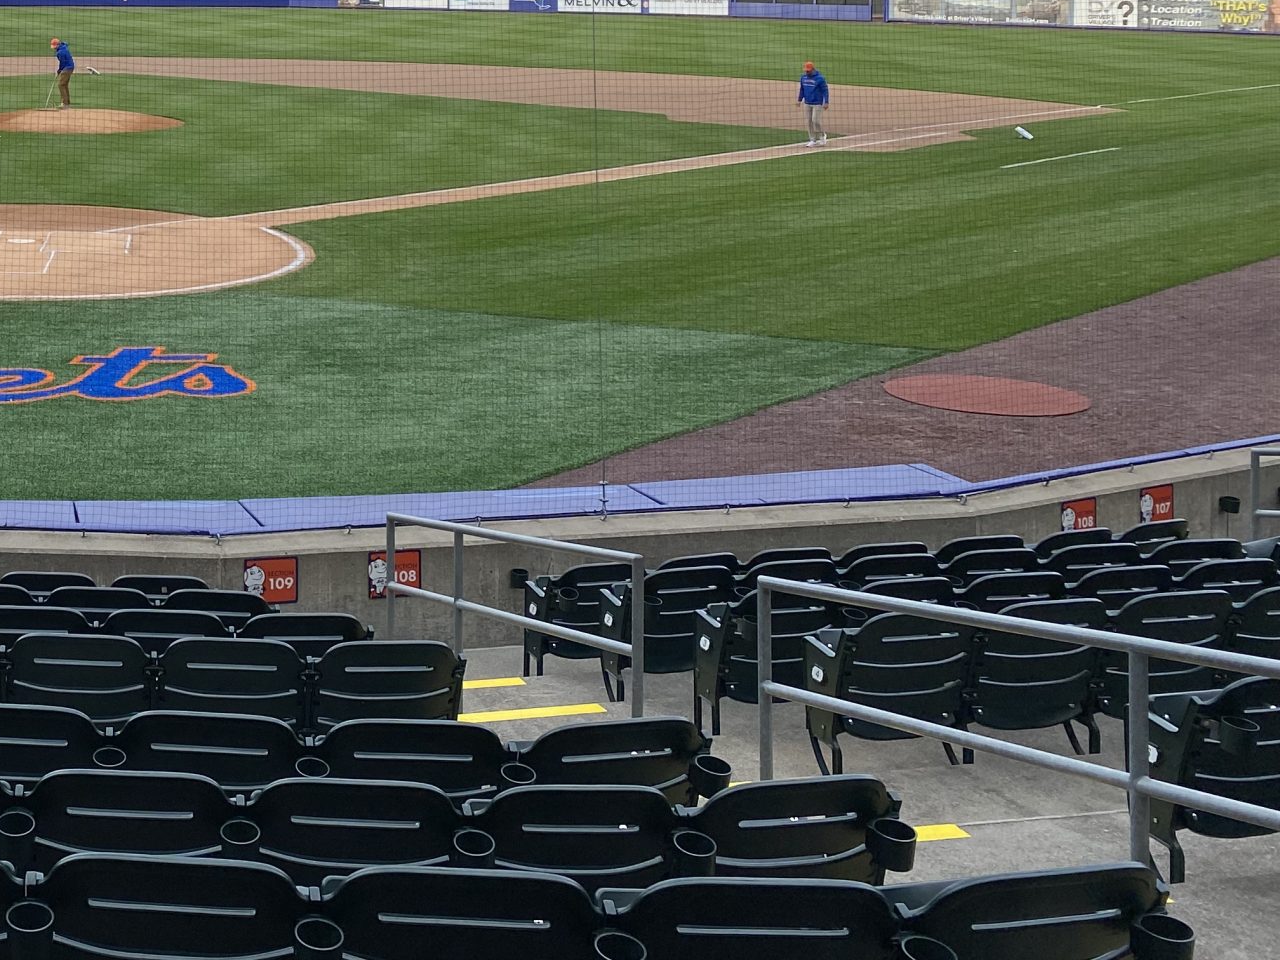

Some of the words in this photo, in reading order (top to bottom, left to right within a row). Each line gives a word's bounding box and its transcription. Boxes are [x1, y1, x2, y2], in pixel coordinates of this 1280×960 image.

[1117, 0, 1134, 26] ?
[1150, 5, 1202, 14] Location
[1151, 17, 1202, 27] Tradition
[1154, 502, 1171, 514] 107
[1077, 516, 1094, 528] 108
[394, 569, 417, 582] 108
[269, 576, 294, 590] 109
